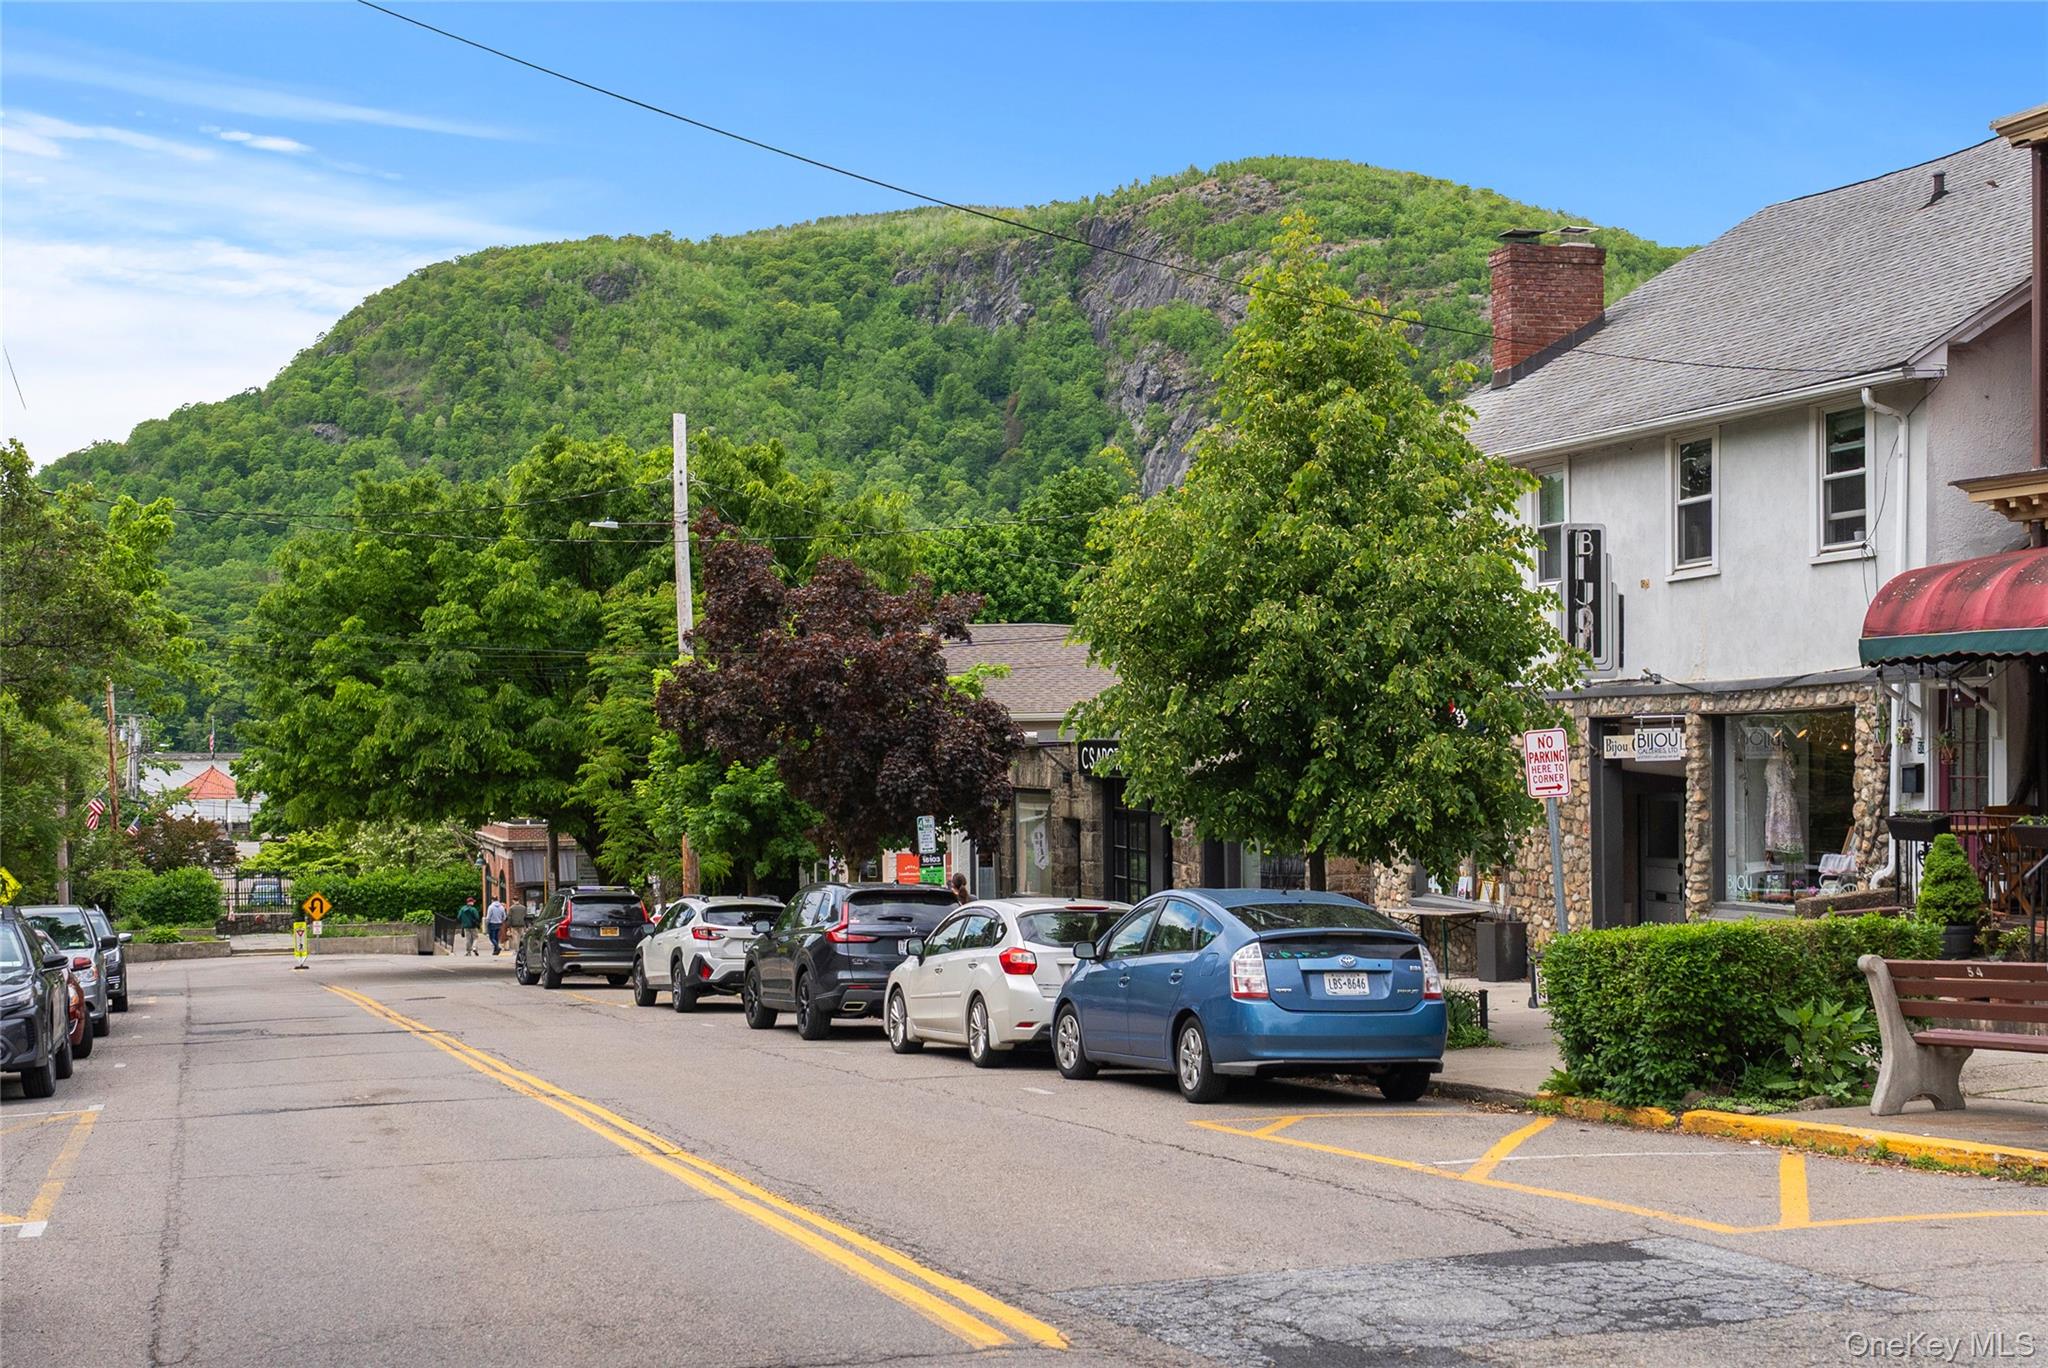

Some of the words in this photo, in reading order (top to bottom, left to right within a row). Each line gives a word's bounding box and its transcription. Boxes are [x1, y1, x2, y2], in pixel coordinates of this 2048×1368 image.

[1537, 736, 1554, 749] NO
[1605, 738, 1628, 757] Bijou
[1637, 732, 1678, 750] BIJOU
[1528, 749, 1565, 764] PARKING
[1531, 764, 1552, 774] HERE
[1554, 763, 1564, 773] TO
[1532, 773, 1565, 784] CORNER
[1728, 874, 1753, 891] BIJOU
[1966, 966, 1983, 978] 54
